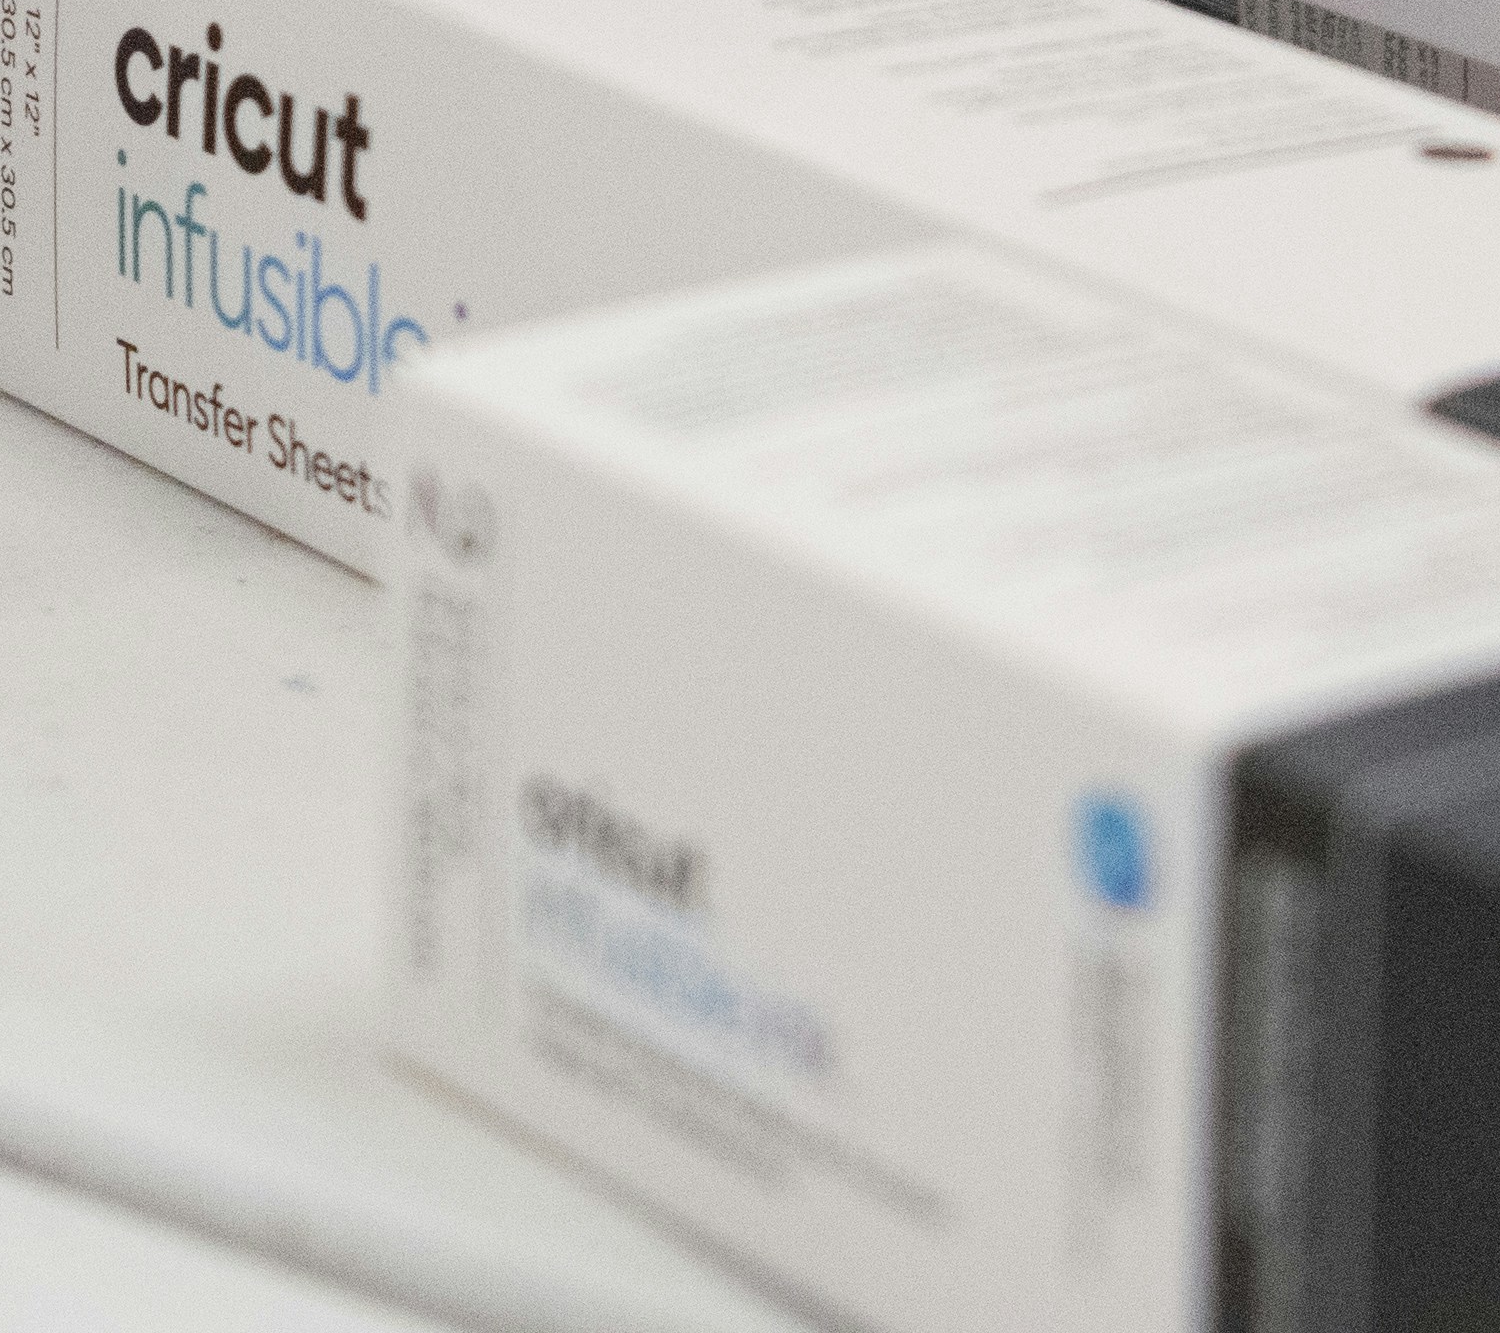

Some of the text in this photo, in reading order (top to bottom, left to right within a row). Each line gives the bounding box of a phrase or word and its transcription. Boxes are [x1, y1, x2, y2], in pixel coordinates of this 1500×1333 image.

[24, 58, 37, 80] x
[1, 76, 13, 127] cm
[115, 21, 372, 222] cricut
[0, 136, 13, 156] x
[1, 164, 17, 237] 30.5
[1, 245, 14, 296] cm
[115, 335, 394, 520] Transfer Sheets
